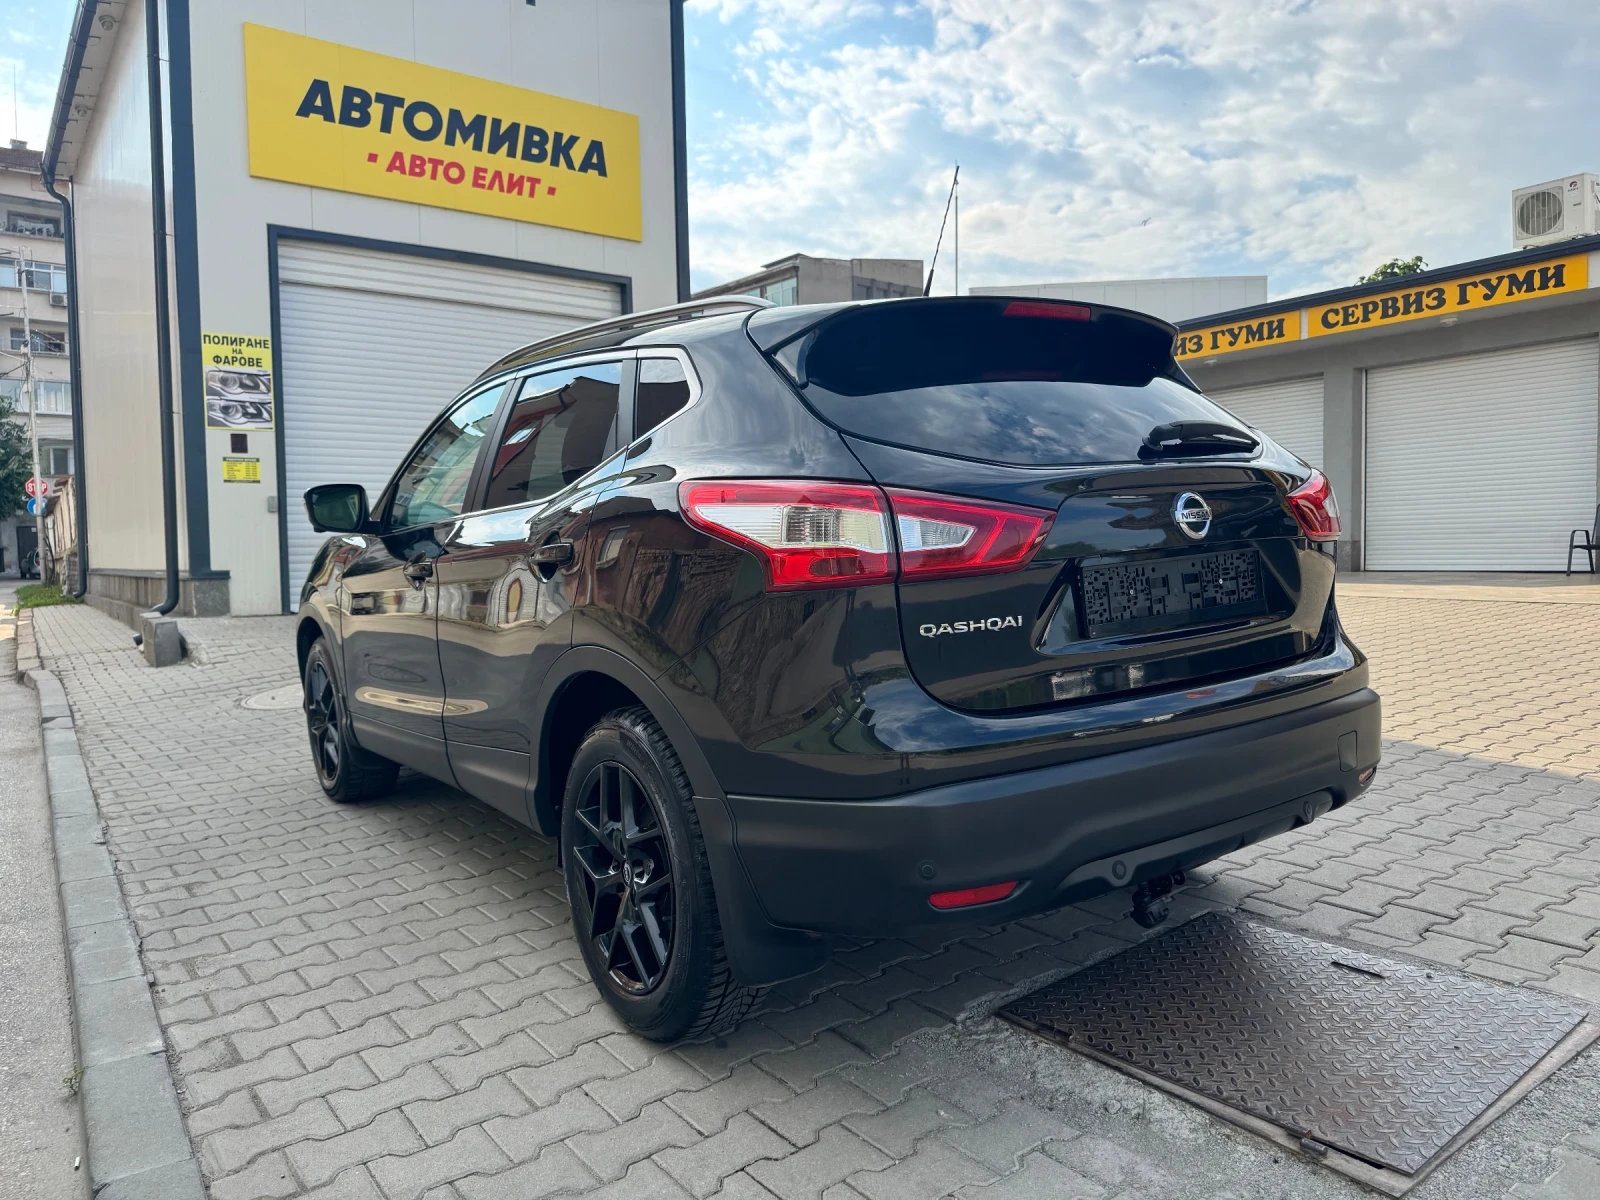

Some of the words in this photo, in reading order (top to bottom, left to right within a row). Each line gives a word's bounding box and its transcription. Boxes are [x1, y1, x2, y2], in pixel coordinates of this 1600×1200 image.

[294, 78, 608, 178] АВТОМИВКА
[385, 151, 466, 185] АВТО
[472, 166, 541, 198] ЕЛИТ
[1321, 286, 1447, 330] СЕРВИЗ
[1457, 263, 1567, 306] ГУМИ
[202, 334, 270, 349] ПОЛИРАНЕ
[1171, 333, 1204, 357] ИЗ
[1210, 317, 1285, 351] ГУМИ
[212, 355, 263, 368] ФАРОВЕ
[28, 483, 47, 492] STP
[919, 614, 1023, 638] QASHQAI
